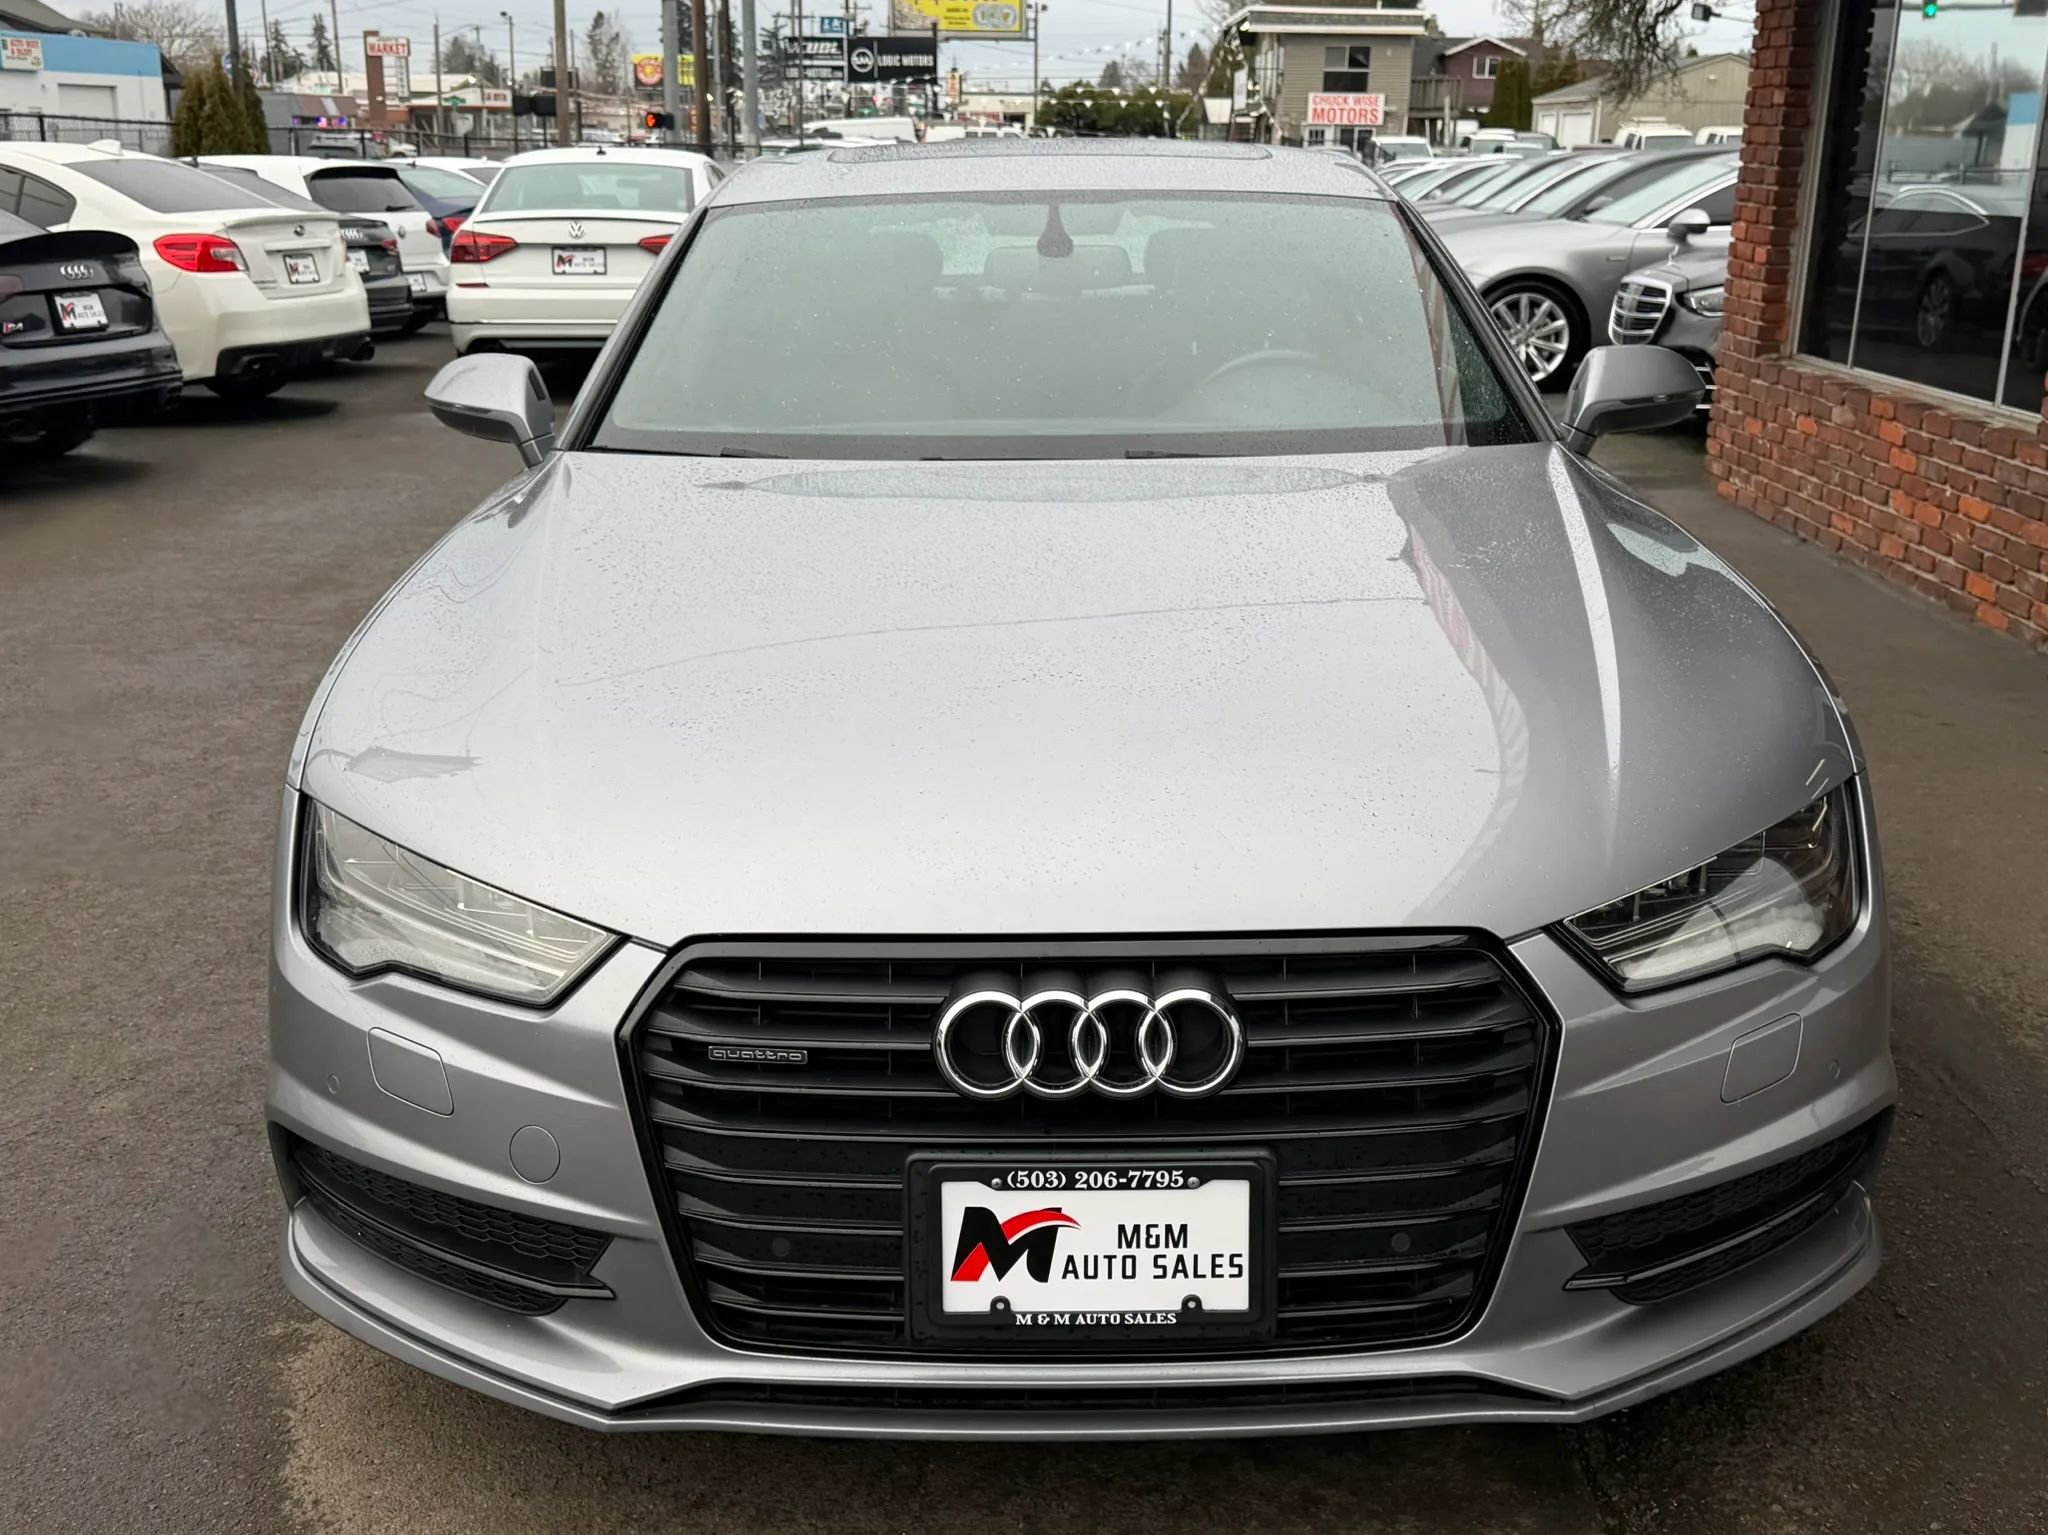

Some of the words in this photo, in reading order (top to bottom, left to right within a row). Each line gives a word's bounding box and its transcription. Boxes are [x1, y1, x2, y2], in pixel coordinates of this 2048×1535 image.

[368, 42, 406, 55] MARKET
[877, 55, 900, 66] LOGIC
[902, 55, 934, 67] MOTORS
[1313, 95, 1350, 106] CHUCK
[1354, 96, 1380, 107] WISE
[1312, 107, 1379, 124] MOTORS
[713, 1049, 802, 1061] quattro
[1007, 1170, 1067, 1189] (503)
[1074, 1169, 1184, 1189] 206-7795
[1117, 1223, 1188, 1249] M&M
[1061, 1254, 1137, 1280] AUTO
[1152, 1253, 1243, 1280] SALES
[1015, 1313, 1032, 1325] M
[1037, 1313, 1050, 1325] &
[1053, 1313, 1071, 1325] M
[1075, 1313, 1121, 1325] AUTO
[1124, 1312, 1177, 1325] SALES
